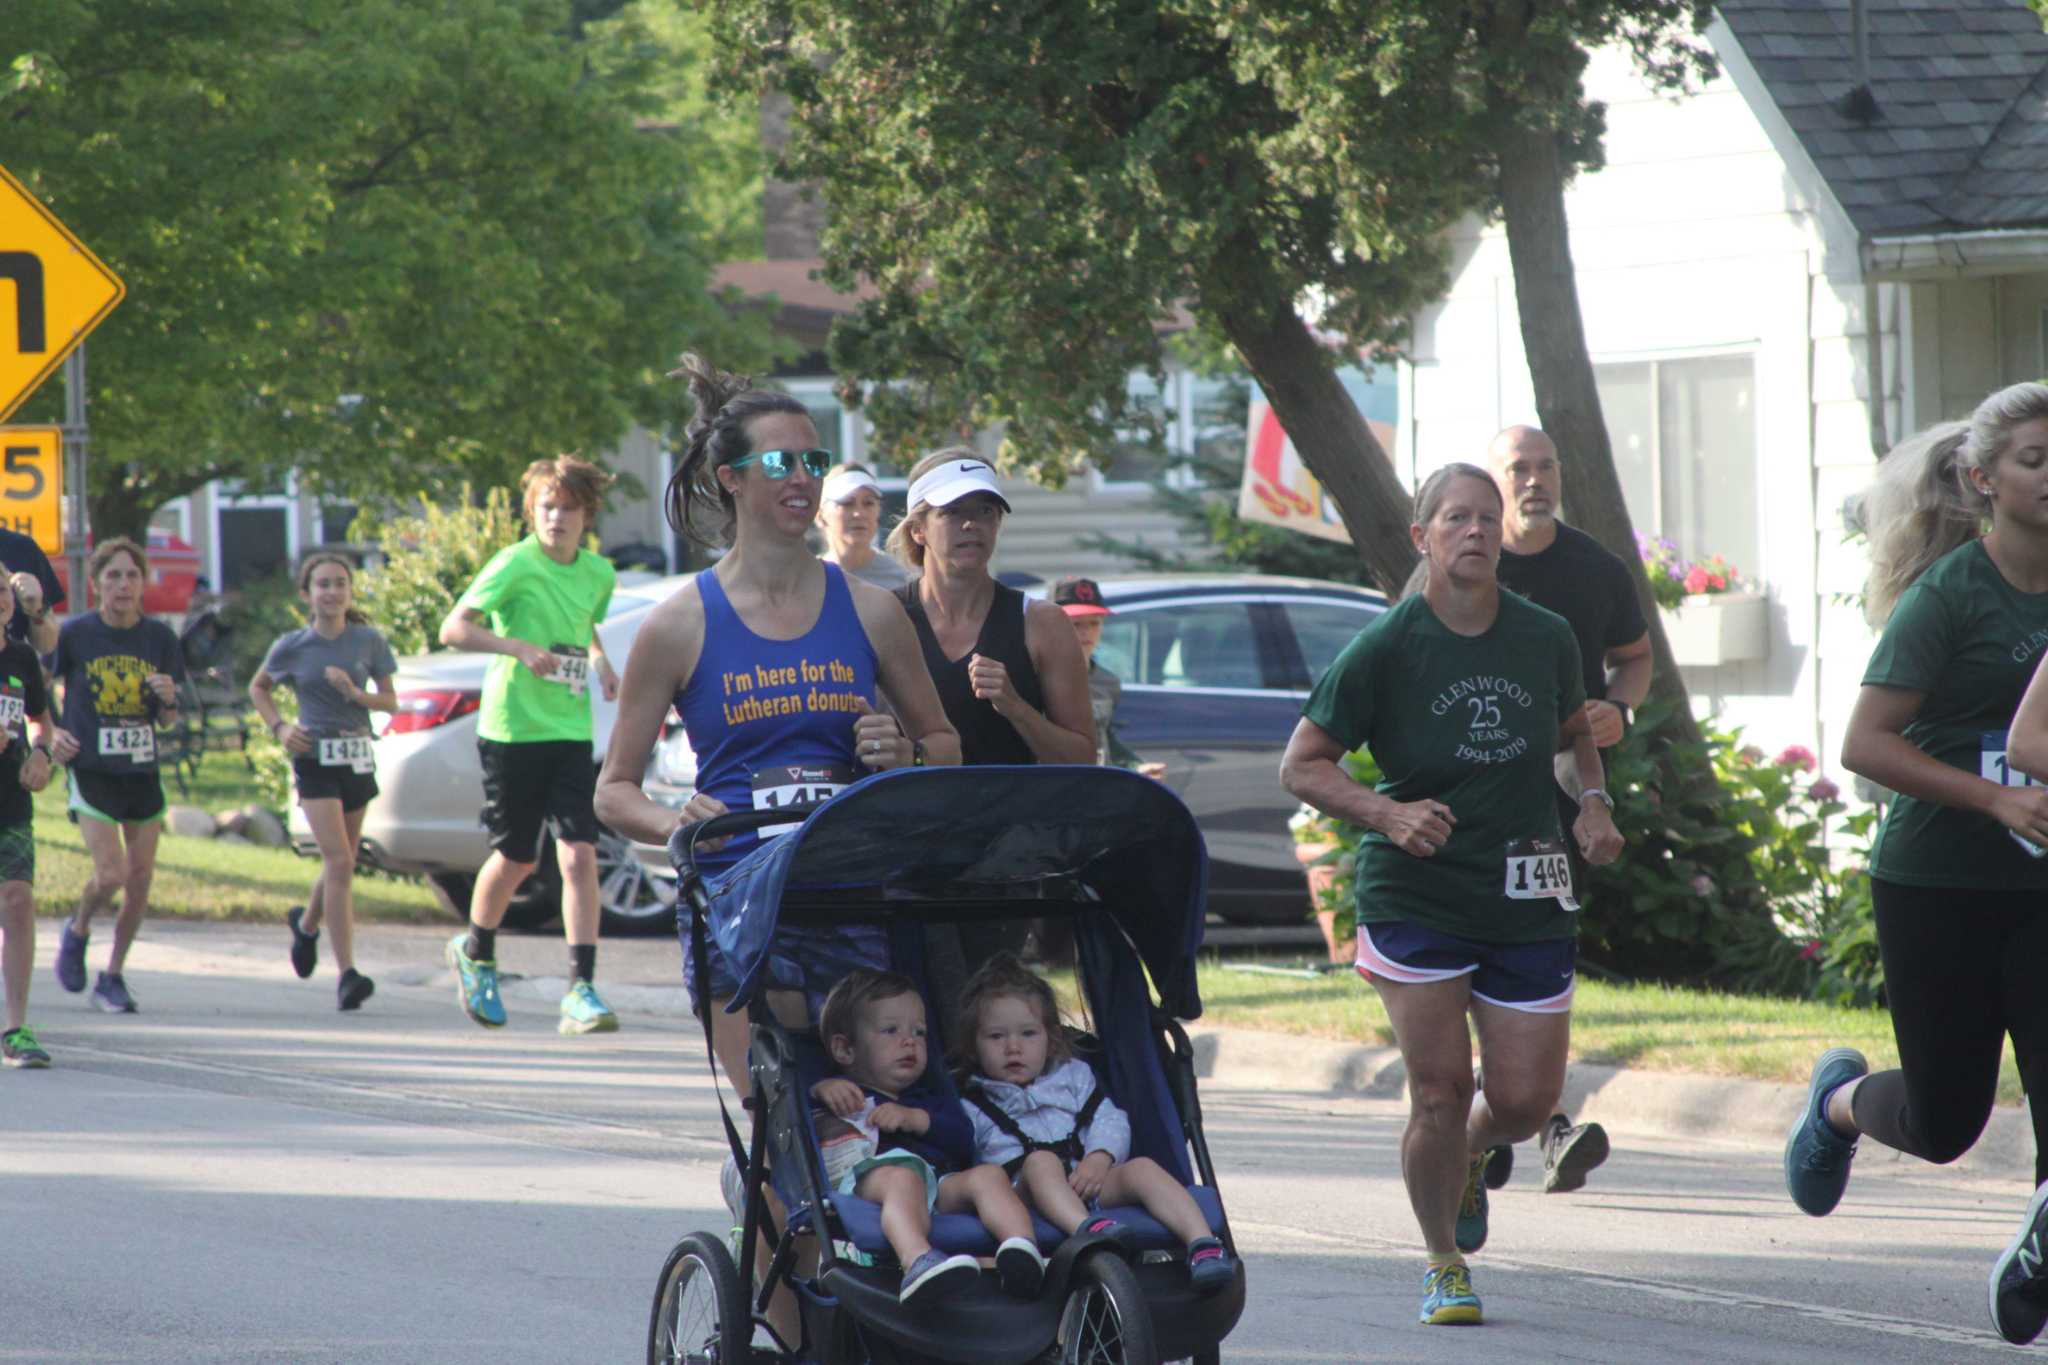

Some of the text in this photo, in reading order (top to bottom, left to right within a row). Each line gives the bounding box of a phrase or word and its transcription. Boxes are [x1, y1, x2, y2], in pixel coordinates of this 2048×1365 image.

[723, 658, 855, 696] I'm here for the
[723, 694, 802, 726] Lutheran
[1431, 675, 1533, 716] GLENWOOD
[1467, 695, 1502, 728] 25
[105, 731, 150, 750] 1422
[326, 741, 368, 759] 1421
[1455, 737, 1528, 764] 1994-2019
[1467, 728, 1510, 742] YEARS
[1515, 857, 1569, 891] 1446
